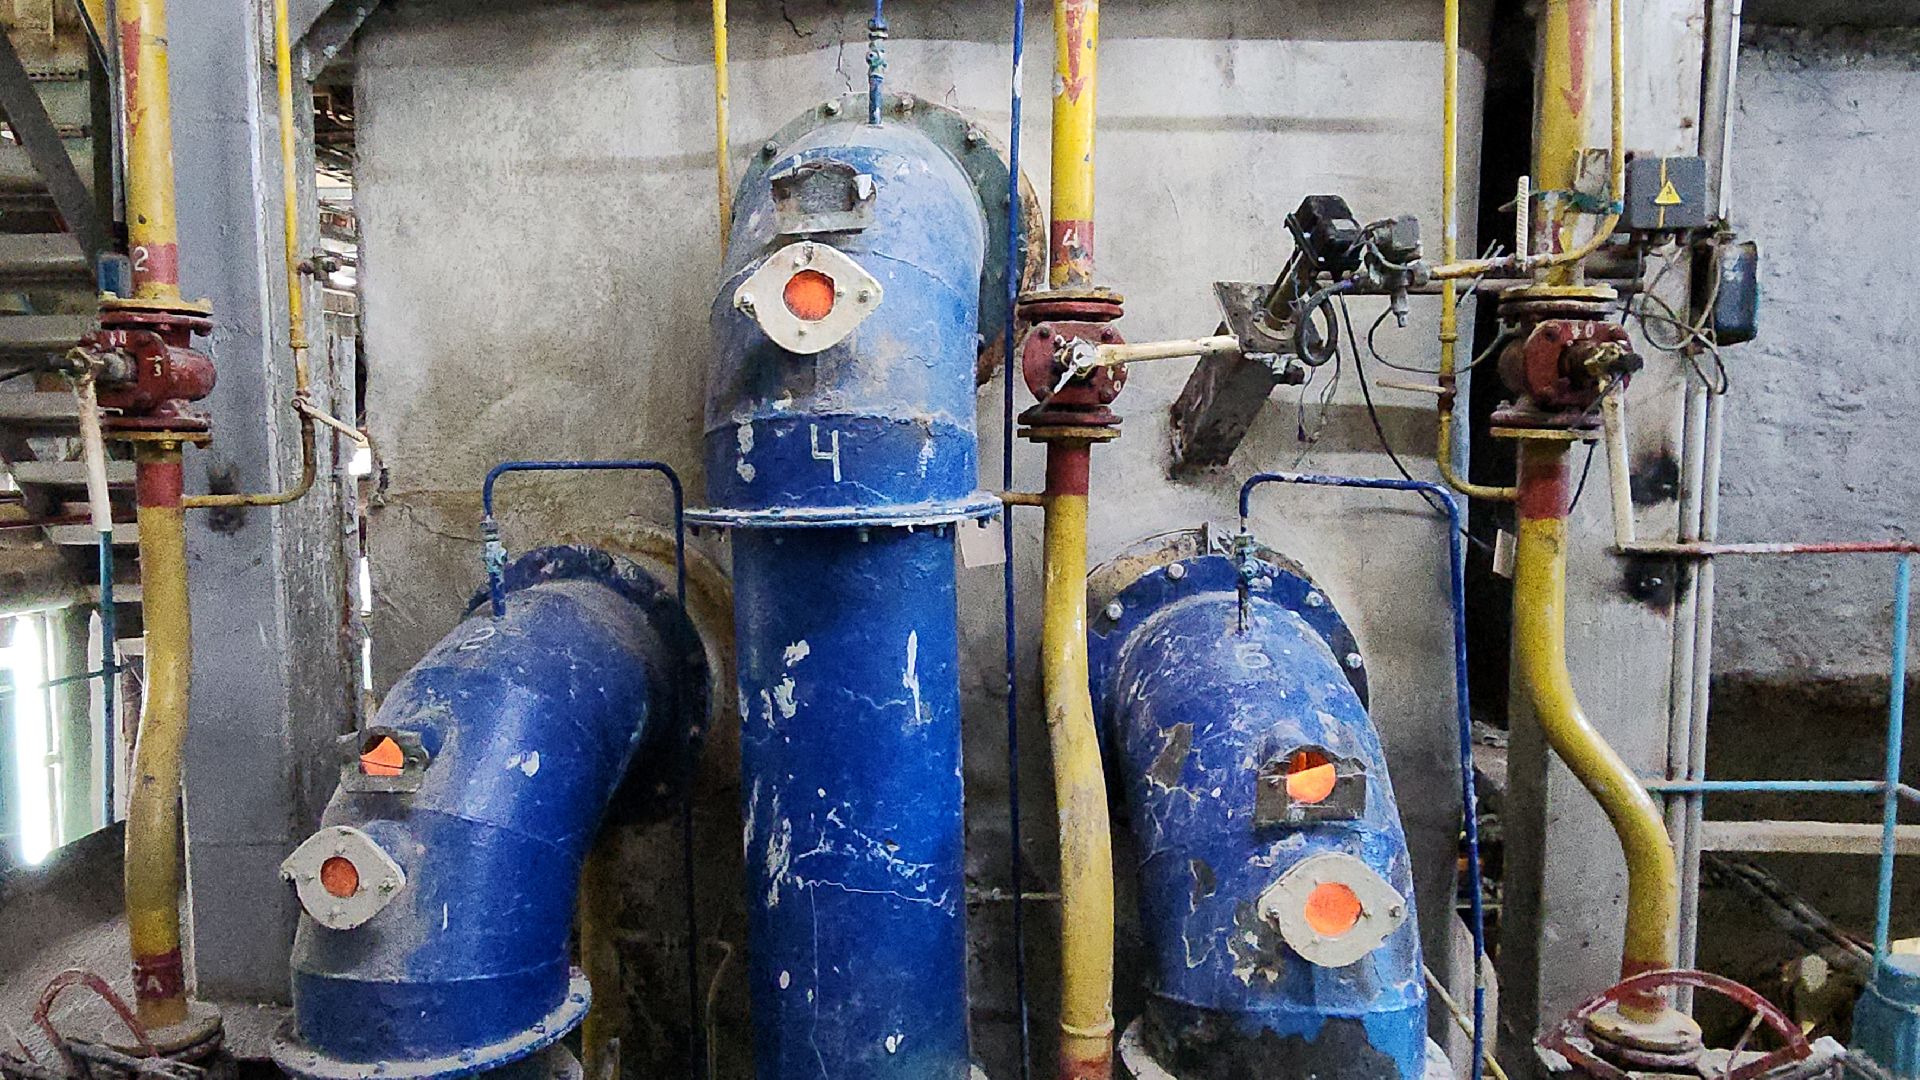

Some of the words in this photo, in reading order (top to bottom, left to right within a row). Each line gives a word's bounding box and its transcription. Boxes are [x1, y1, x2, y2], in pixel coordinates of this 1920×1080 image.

[1062, 226, 1079, 249] 4
[134, 246, 149, 272] 2
[809, 423, 842, 483] 4
[459, 626, 496, 651] 2
